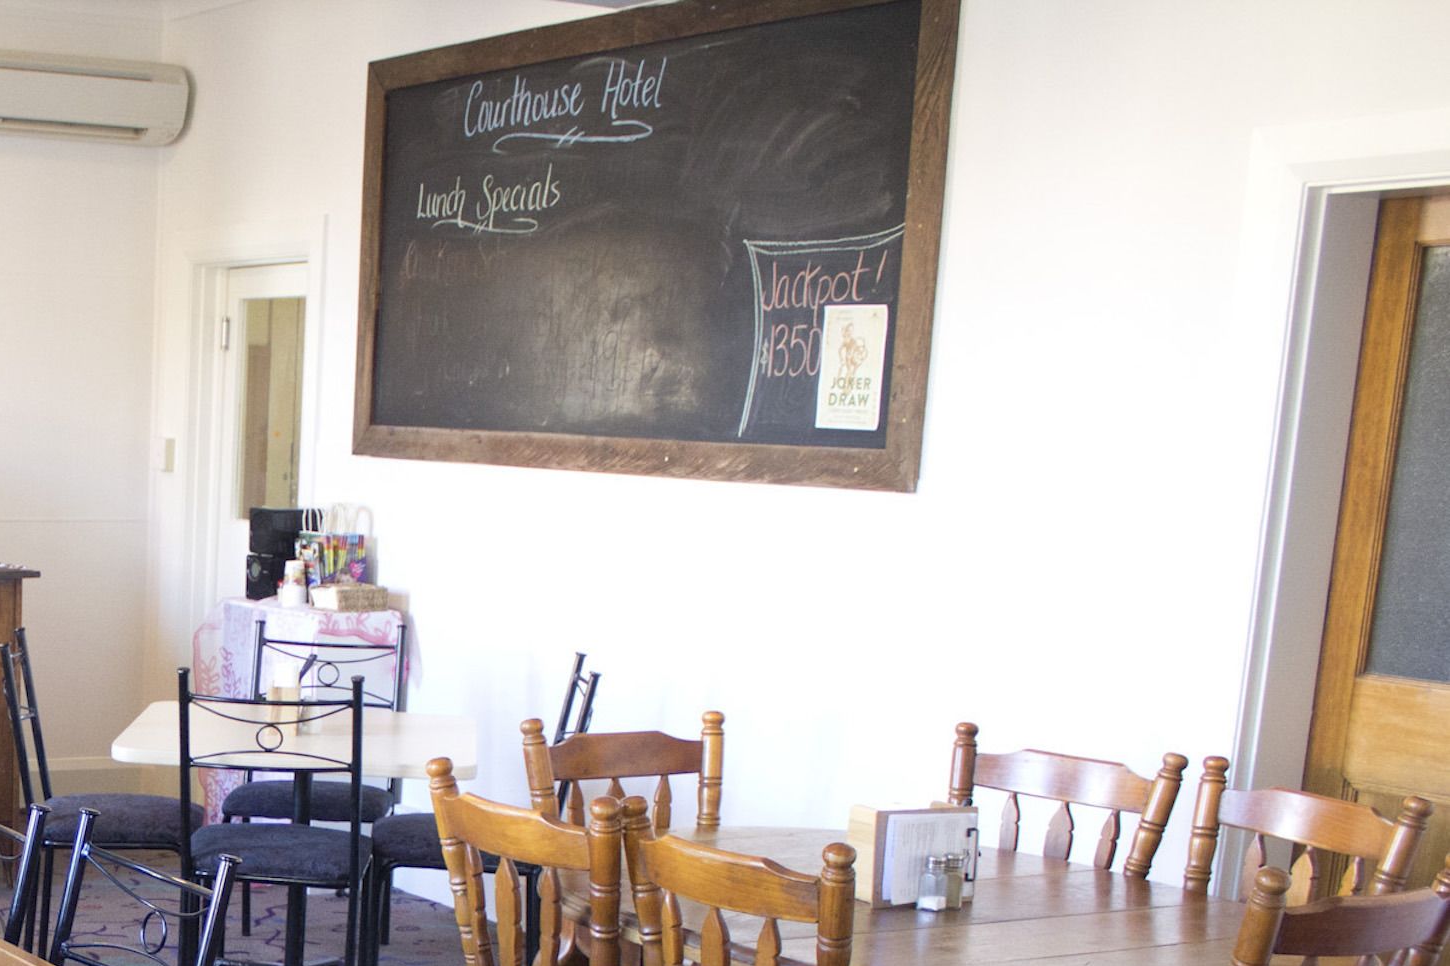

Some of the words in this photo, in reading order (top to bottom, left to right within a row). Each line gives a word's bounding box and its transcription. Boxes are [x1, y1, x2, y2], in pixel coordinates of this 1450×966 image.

[464, 75, 585, 137] Courthouse
[601, 56, 668, 119] Hotel
[416, 175, 466, 228] Lunch
[476, 162, 561, 231] Specials
[828, 393, 870, 407] DRAW
[831, 377, 871, 391] JOKER
